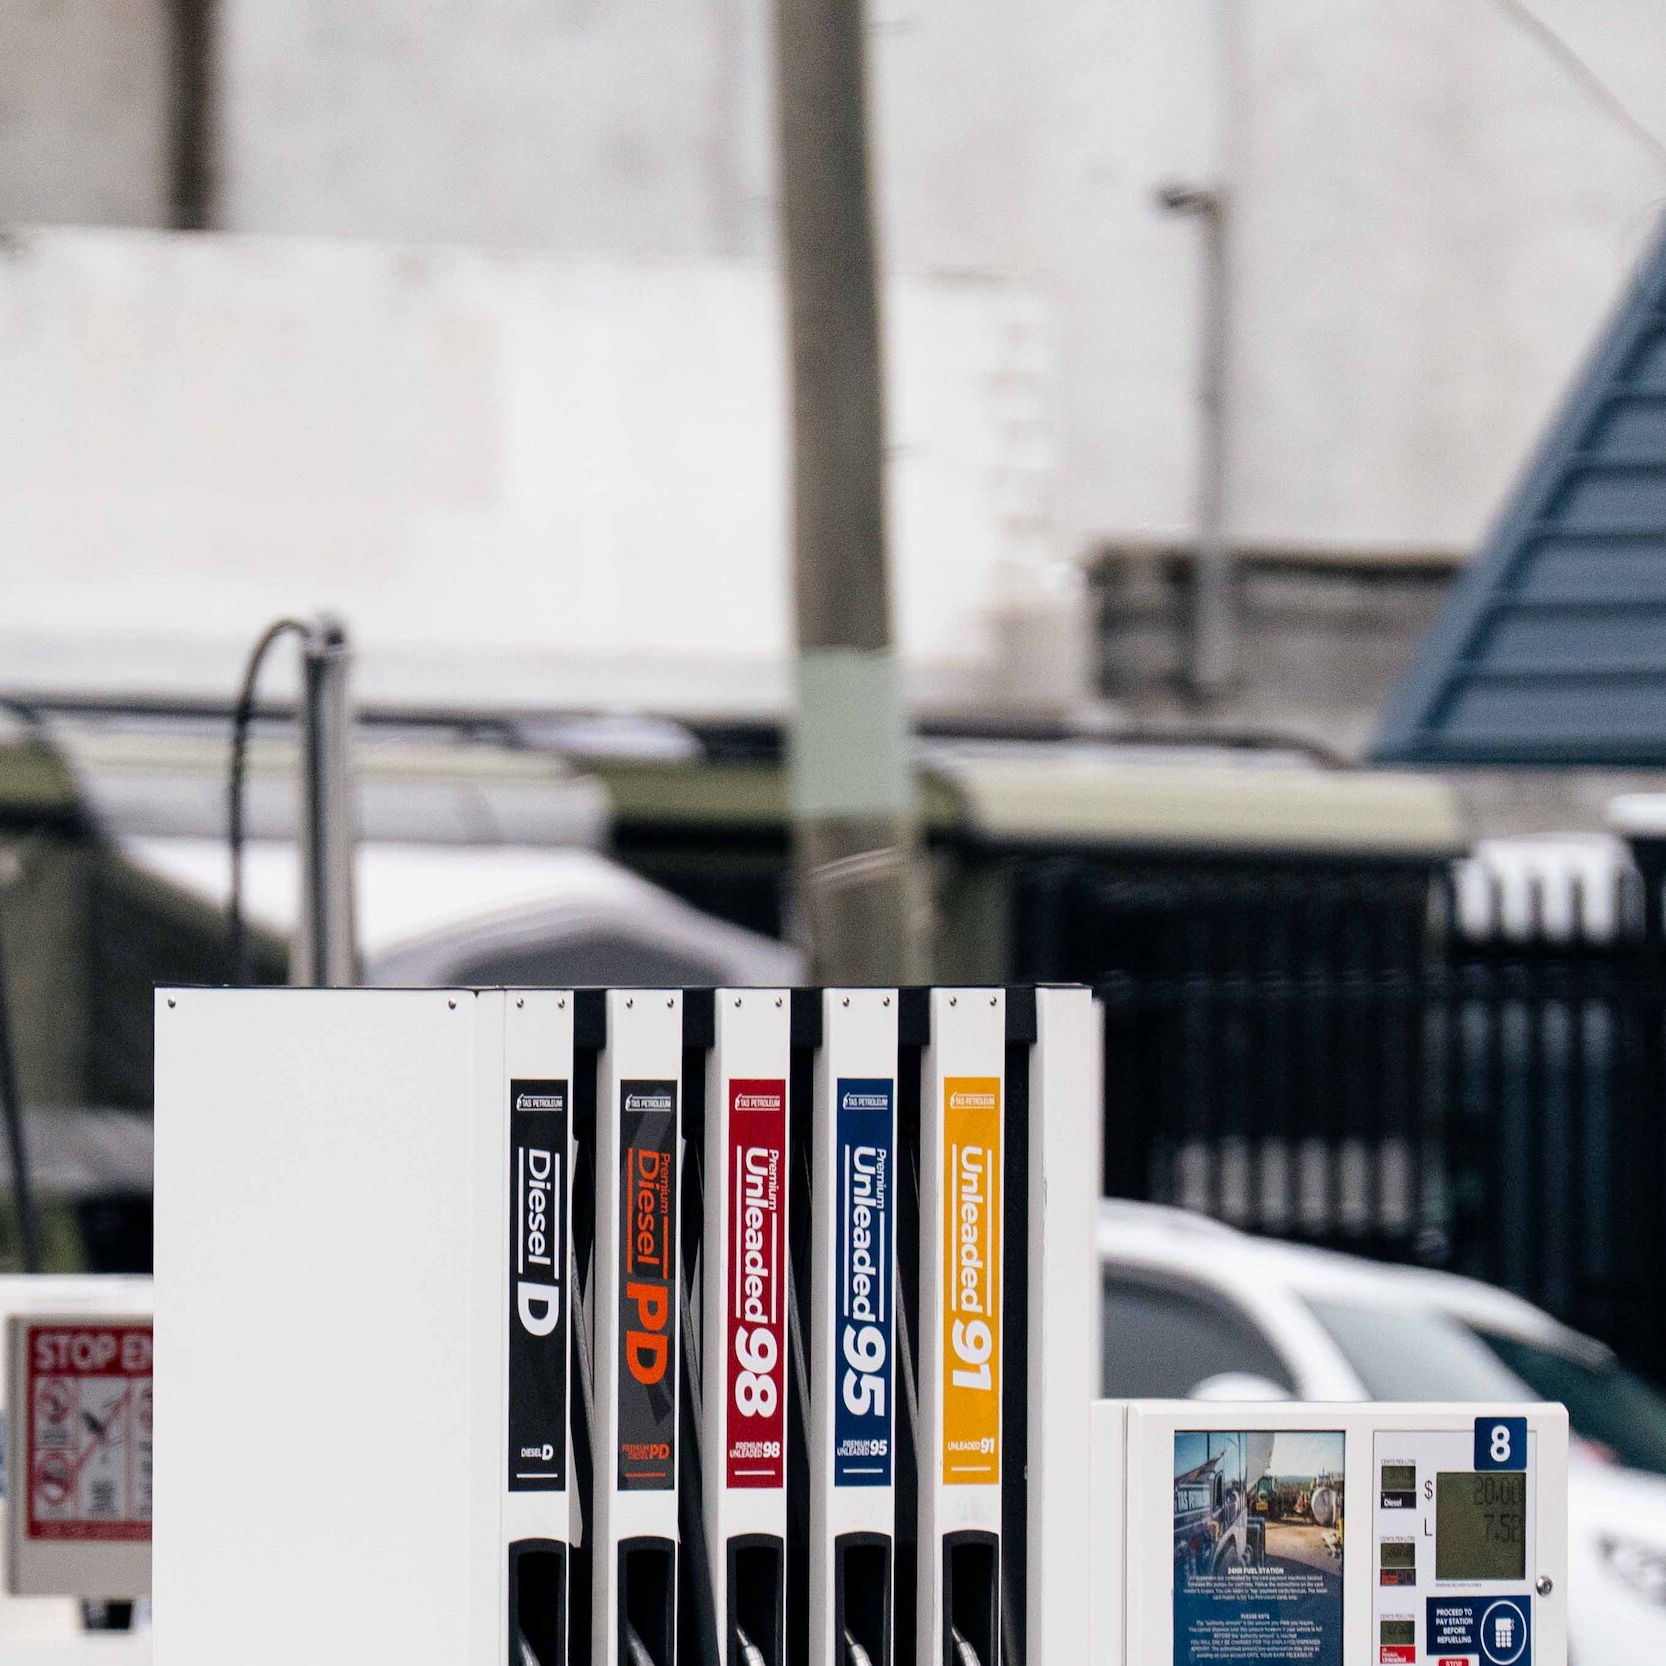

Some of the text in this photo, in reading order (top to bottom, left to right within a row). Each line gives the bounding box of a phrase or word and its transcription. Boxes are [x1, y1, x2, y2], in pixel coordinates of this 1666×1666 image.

[522, 1099, 563, 1107] TAS PETROLEUM
[631, 1099, 671, 1108] TAS PETROLEUM
[740, 1098, 780, 1107] TAS PETROLEUM
[848, 1098, 888, 1106] TAS PETROLEUM
[955, 1097, 994, 1105] TAS PETROLEUM
[659, 1153, 671, 1214] Premium
[768, 1149, 780, 1210] Premium
[876, 1148, 887, 1209] Premium
[517, 1149, 560, 1336] Diesel D
[626, 1149, 668, 1385] Diesel PD
[951, 1146, 992, 1391] Unleaded 91
[734, 1147, 777, 1418] Unleaded 98
[842, 1146, 886, 1417] Unleaded 95
[35, 1334, 117, 1371] STOP
[521, 1444, 554, 1460] DIESEL D
[649, 1443, 670, 1460] PD
[729, 1441, 780, 1458] UNLEADED 98
[735, 1441, 762, 1449] PREMIUM
[837, 1440, 888, 1457] UNLEADED 95
[842, 1440, 870, 1448] PREMIUM
[947, 1438, 994, 1454] UNLEADED 91
[1489, 1425, 1511, 1462] 8
[1424, 1480, 1433, 1500] $
[1383, 1498, 1402, 1507] Diesel
[1424, 1518, 1433, 1536] L
[1436, 1608, 1473, 1616] PROCEED TO
[1436, 1617, 1473, 1626] PAY STATION
[1437, 1636, 1472, 1644] REFUELLING
